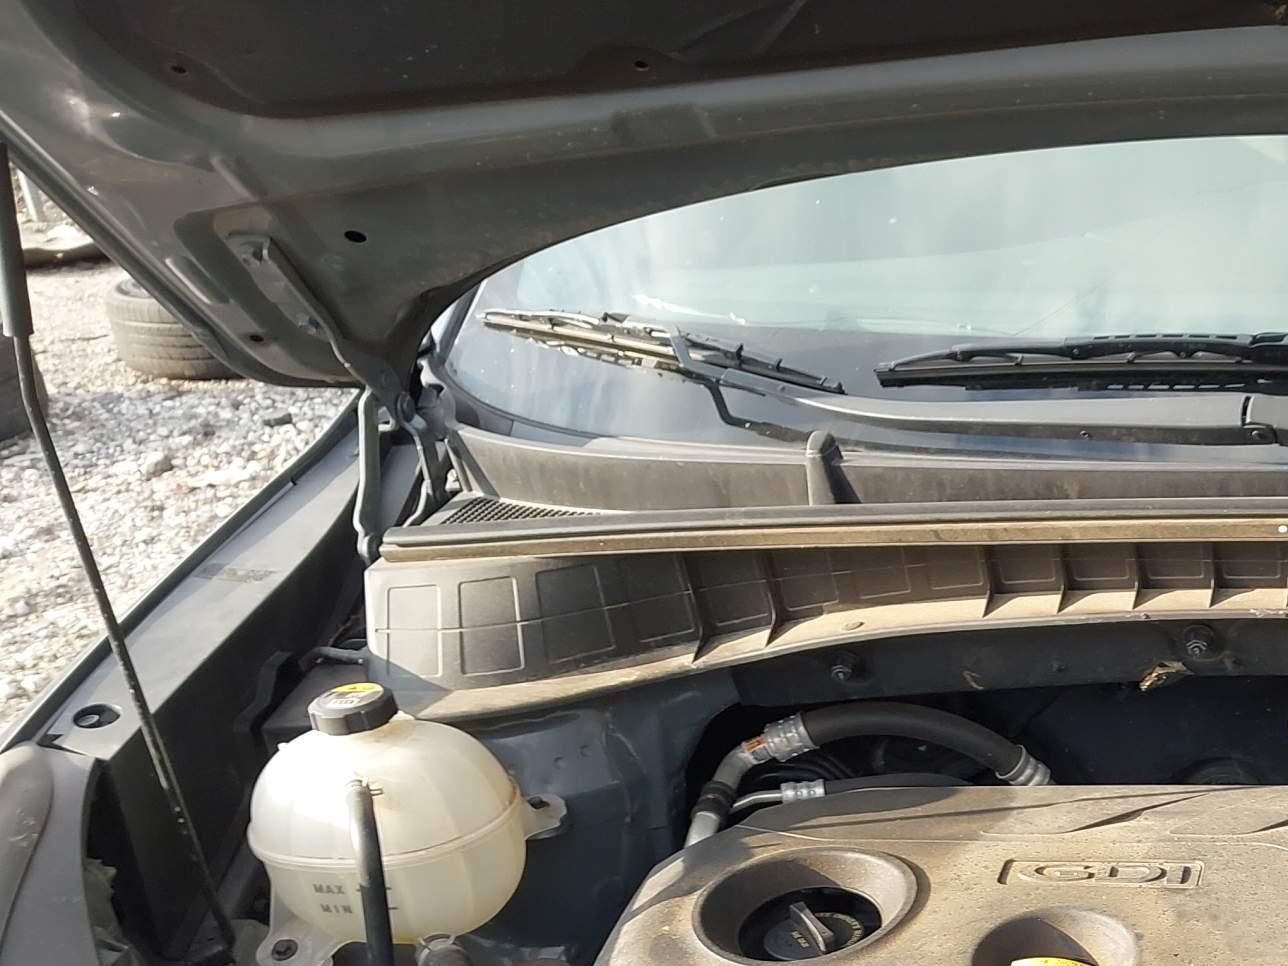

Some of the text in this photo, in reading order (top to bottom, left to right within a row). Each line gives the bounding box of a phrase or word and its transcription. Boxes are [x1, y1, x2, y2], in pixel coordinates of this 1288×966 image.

[1017, 862, 1194, 886] GDI
[312, 883, 346, 895] MAX
[319, 903, 354, 914] MIN
